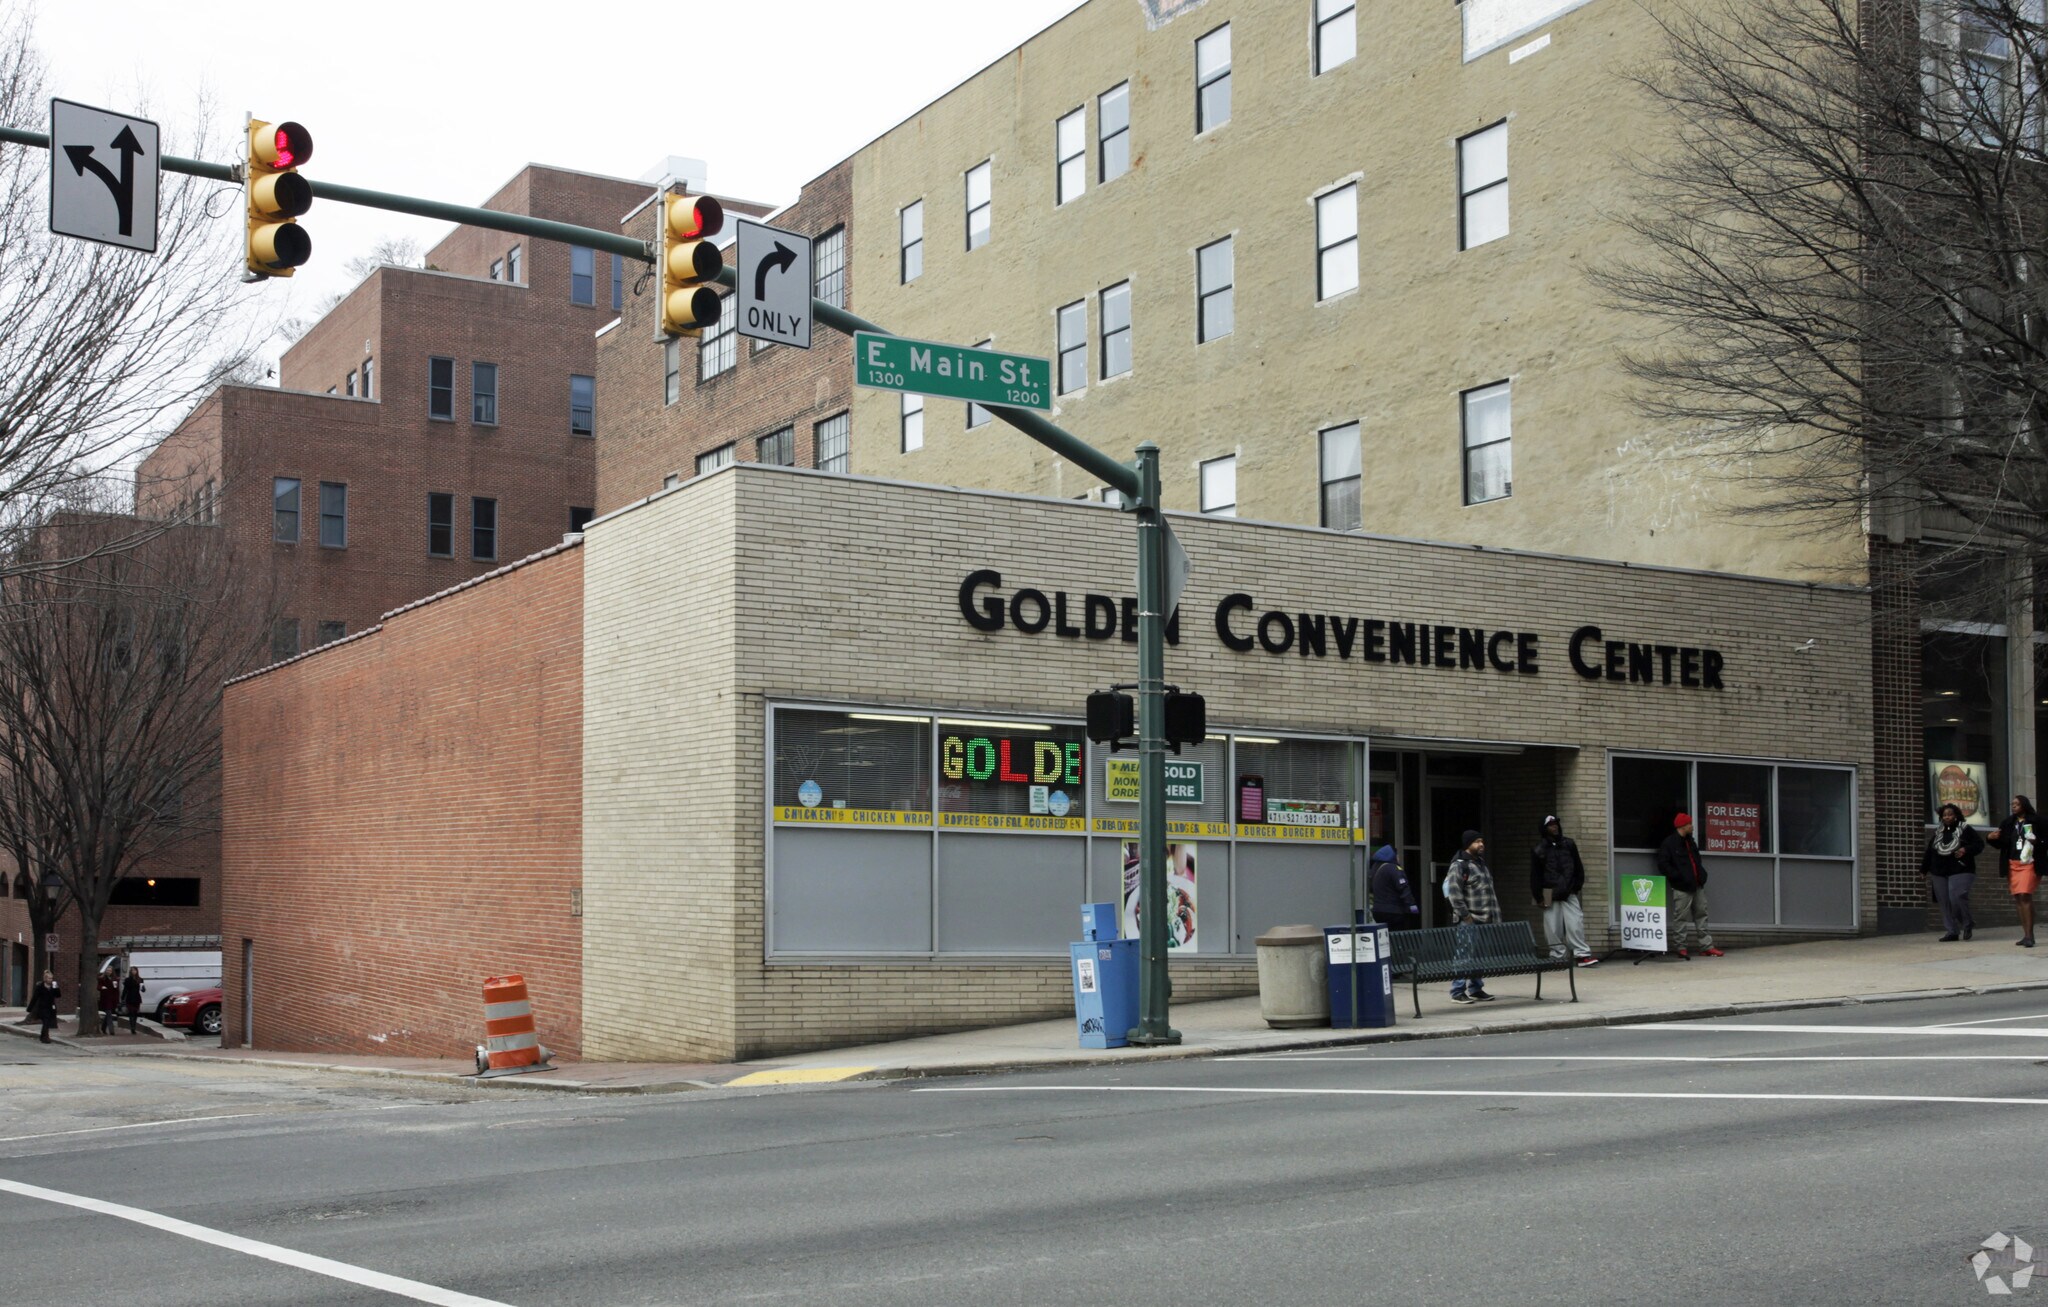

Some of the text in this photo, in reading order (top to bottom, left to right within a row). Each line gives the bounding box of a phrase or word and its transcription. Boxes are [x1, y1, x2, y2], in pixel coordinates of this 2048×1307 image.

[748, 306, 801, 337] ONLY
[867, 341, 1039, 388] E. Main St.
[868, 370, 904, 387] 1300
[1006, 389, 1040, 405] 1200
[1215, 593, 1539, 675] CONVENIENCE
[1568, 625, 1725, 690] CENTER
[943, 736, 1083, 785] GOLDE
[1165, 766, 1196, 779] SOLD
[1113, 777, 1140, 786] MON
[1112, 788, 1140, 797] ORDE
[1165, 785, 1195, 797] HERE
[852, 810, 896, 823] CHICKEN
[903, 811, 930, 824] WRAP
[1707, 805, 1758, 818] FOR LEASE
[1244, 826, 1277, 837] BURGER
[1283, 827, 1315, 838] BURGER
[1321, 828, 1351, 839] BURGER
[1707, 838, 1759, 850] (804) 357-2414
[1625, 908, 1661, 923] we're
[1623, 927, 1663, 941] game
